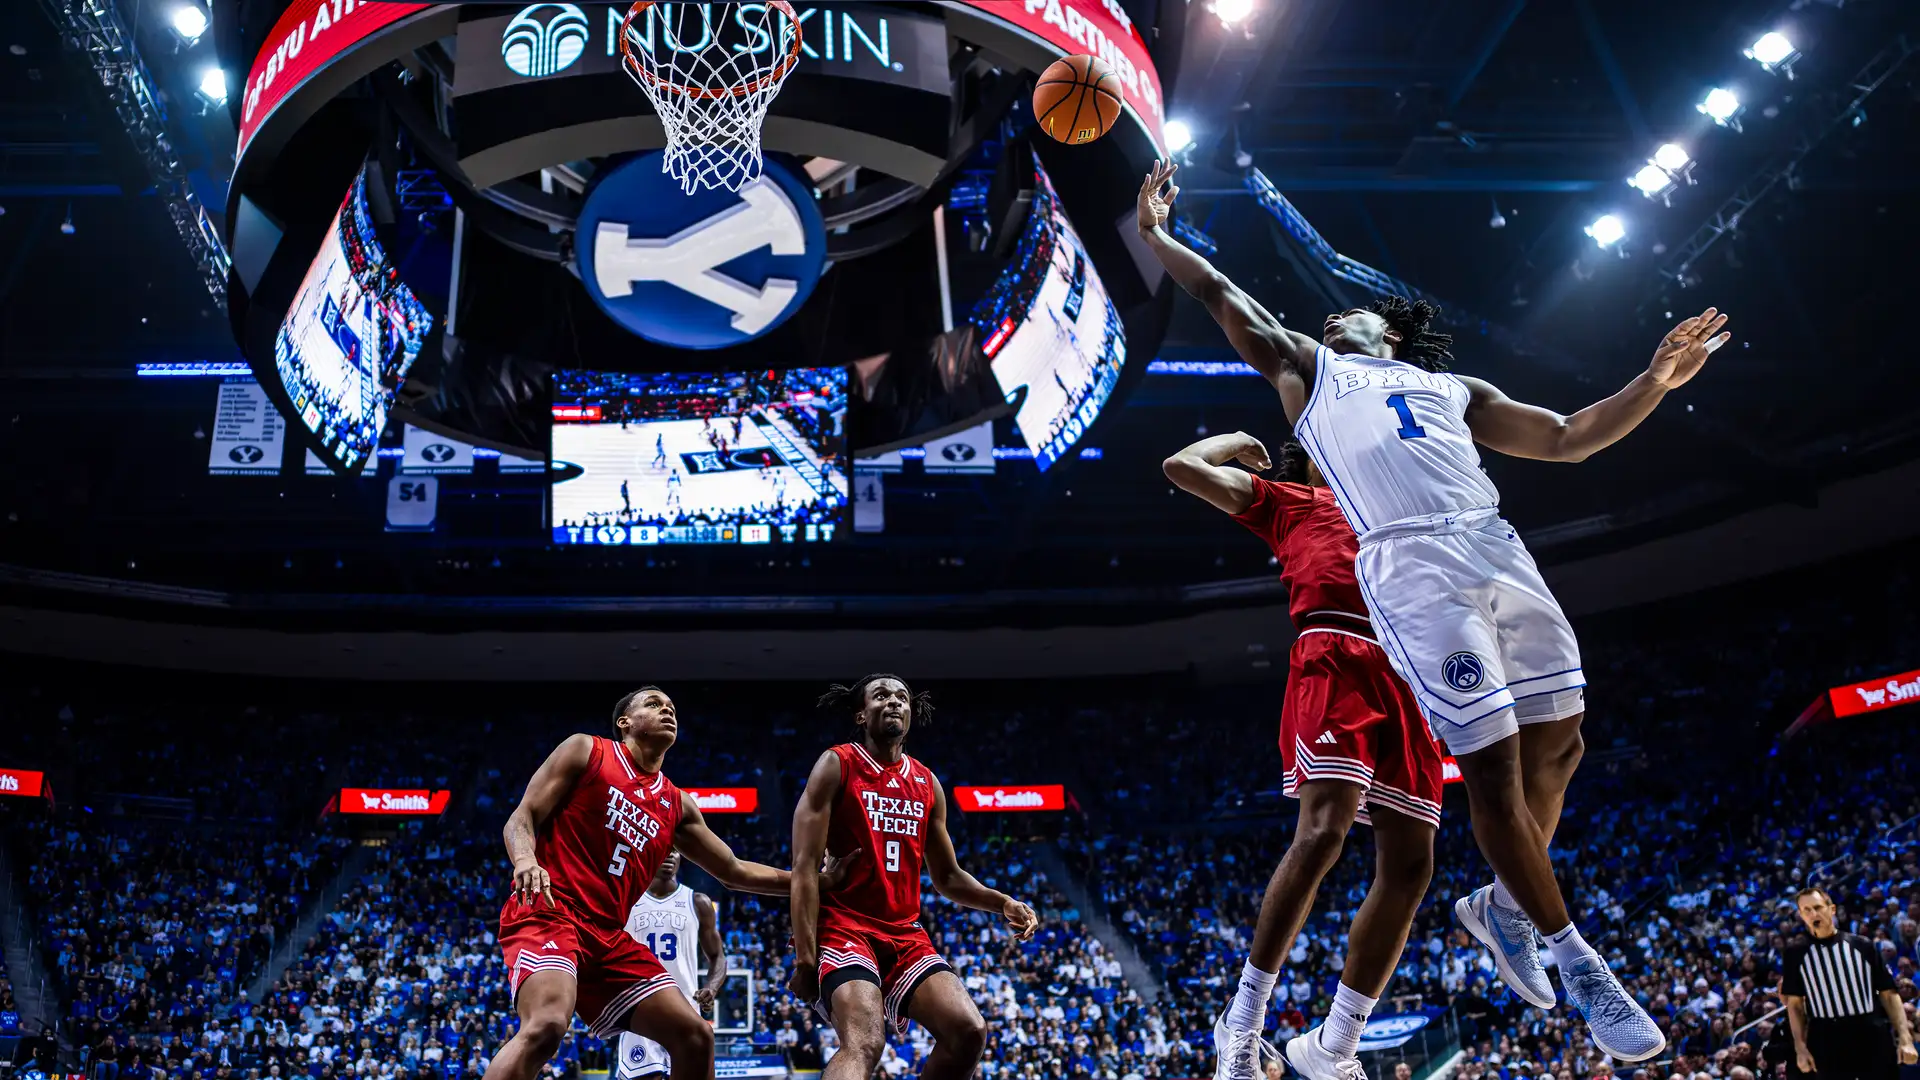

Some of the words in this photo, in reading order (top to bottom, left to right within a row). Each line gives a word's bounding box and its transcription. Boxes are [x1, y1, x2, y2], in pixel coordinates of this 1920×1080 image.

[606, 2, 711, 56] NU
[733, 4, 890, 68] SKIN
[263, 20, 307, 90] BYU
[1332, 369, 1452, 401] BYU
[1385, 394, 1428, 440] 1
[399, 482, 427, 502] 54
[606, 785, 661, 839] TEXAS
[861, 790, 925, 819] TEXAS
[605, 807, 649, 852] TECH
[868, 811, 919, 837] TECH
[607, 843, 632, 877] 5
[885, 840, 901, 873] 9
[633, 909, 688, 933] BYU
[646, 932, 678, 962] 13
